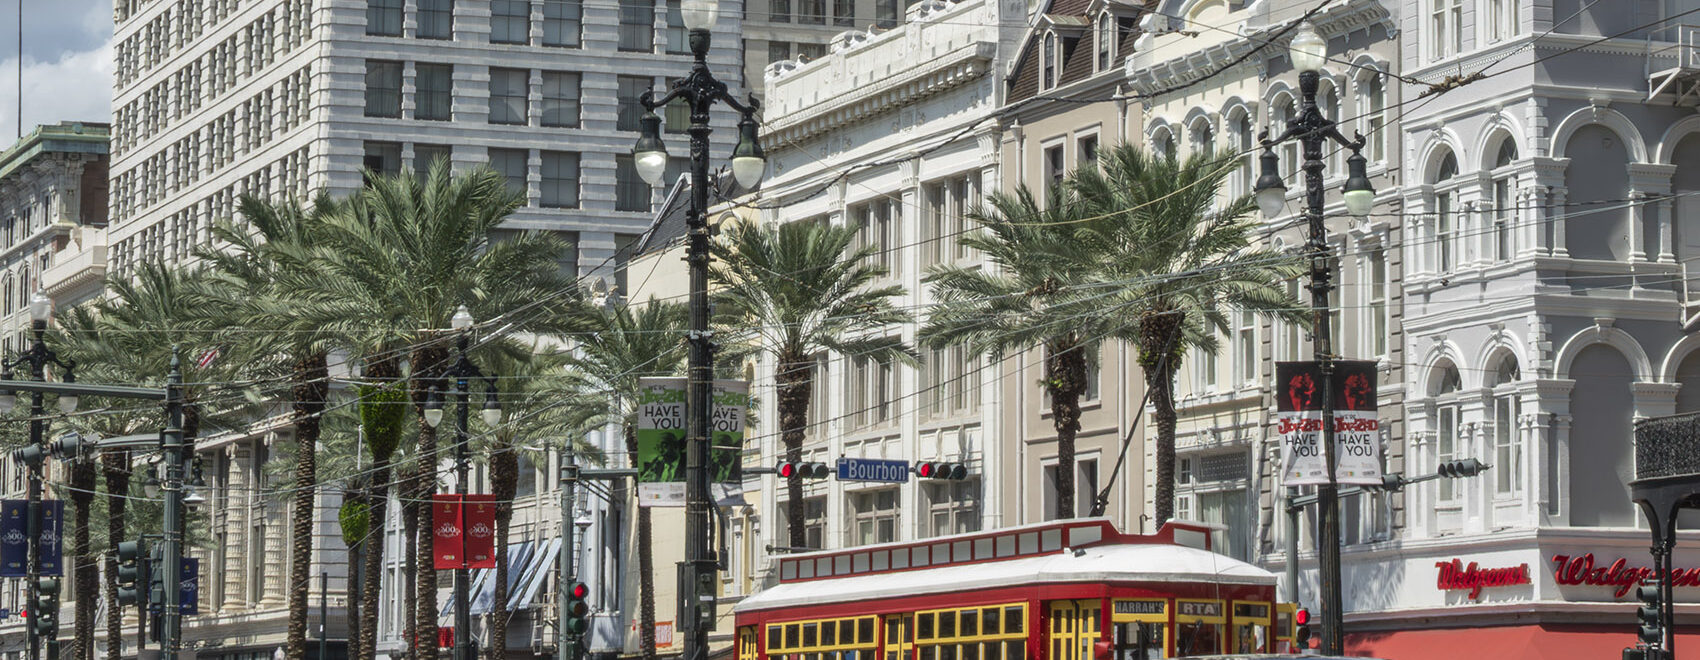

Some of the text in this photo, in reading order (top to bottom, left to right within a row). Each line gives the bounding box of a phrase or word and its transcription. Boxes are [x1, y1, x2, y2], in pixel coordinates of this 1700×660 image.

[644, 406, 680, 418] HAVE
[713, 408, 738, 420] AVE
[652, 418, 681, 430] YOU
[712, 421, 738, 432] YOU
[1285, 434, 1317, 446] HAVE
[1338, 434, 1370, 445] HAVE
[1292, 446, 1319, 457] YOU
[1345, 446, 1373, 457] YOU
[848, 460, 906, 481] Bourbon
[1435, 558, 1531, 600] Walgreens
[1552, 553, 1700, 598] Walgren
[1115, 601, 1164, 613] HARRAH'S
[1183, 603, 1215, 614] RTA
